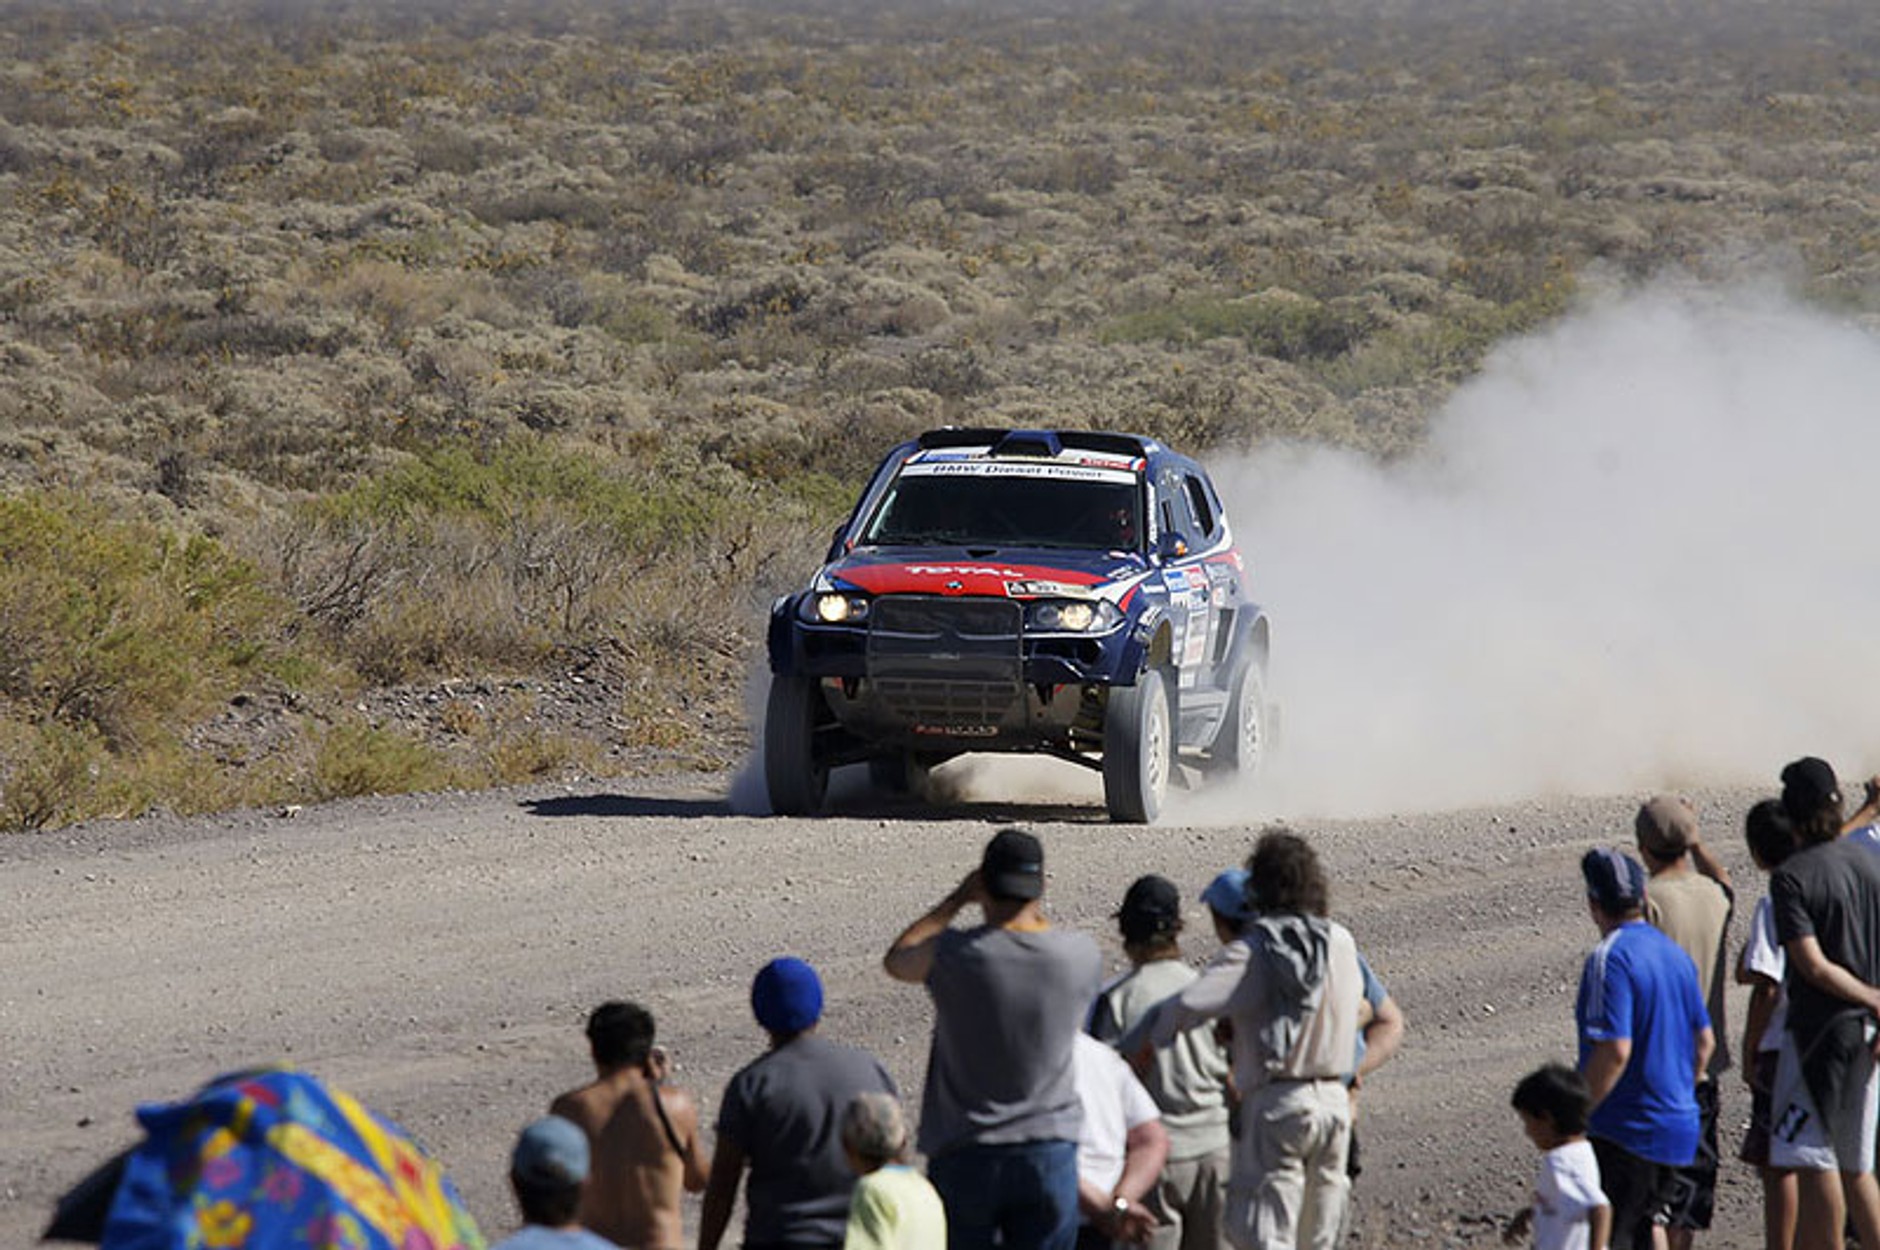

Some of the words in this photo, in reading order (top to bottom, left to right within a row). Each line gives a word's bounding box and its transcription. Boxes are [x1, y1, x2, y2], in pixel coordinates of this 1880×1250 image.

[933, 465, 980, 474] BMW
[984, 466, 1042, 475] Diesel
[905, 566, 1025, 577] TOTAL
